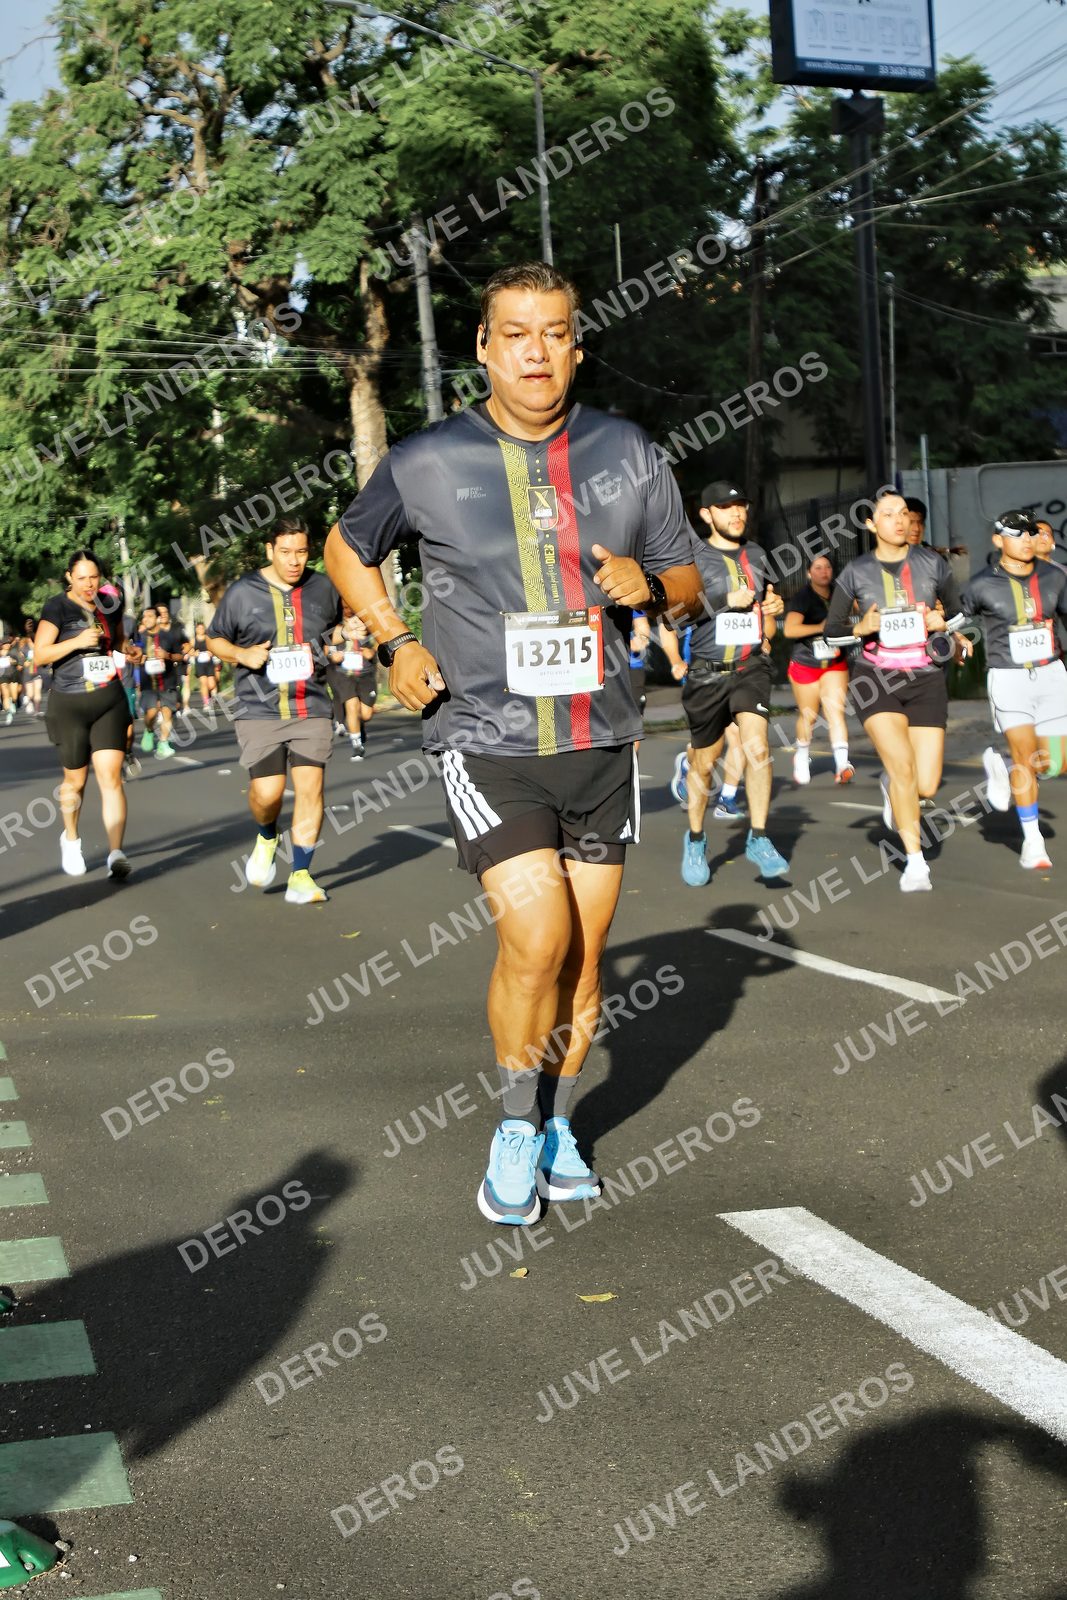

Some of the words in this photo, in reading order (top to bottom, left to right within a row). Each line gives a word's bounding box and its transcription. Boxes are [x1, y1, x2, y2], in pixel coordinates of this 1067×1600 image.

[723, 617, 753, 630] 9844
[884, 617, 915, 632] 9843
[1017, 633, 1046, 649] 9842
[511, 636, 592, 668] 13215
[88, 659, 110, 672] 8424
[270, 655, 307, 670] 13016
